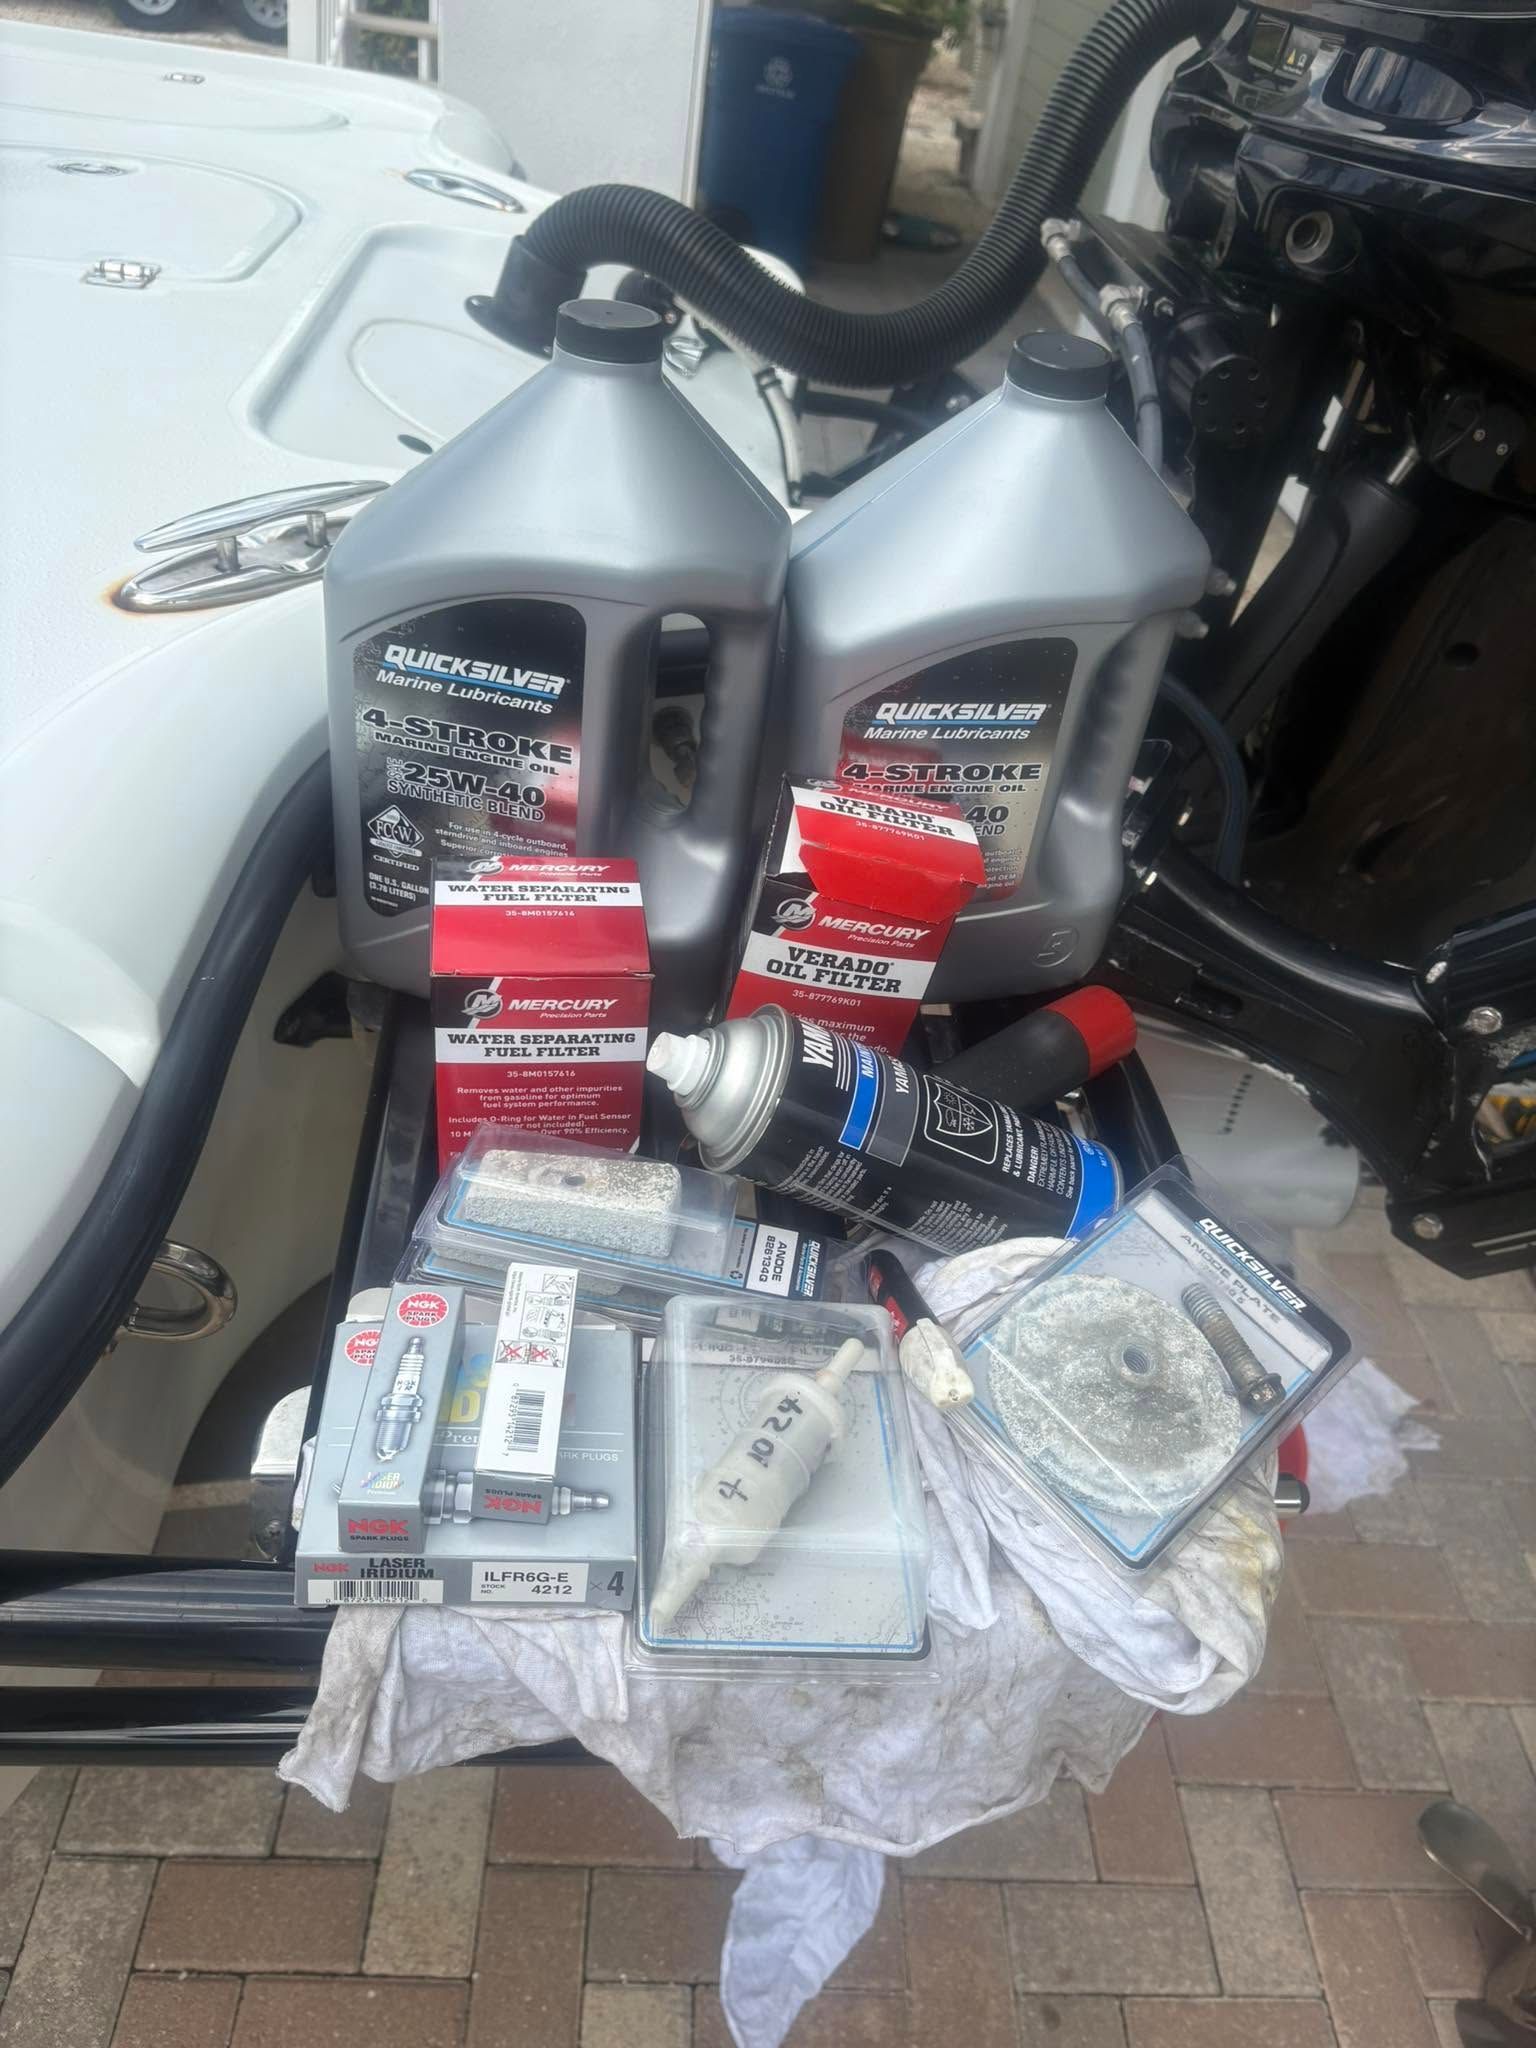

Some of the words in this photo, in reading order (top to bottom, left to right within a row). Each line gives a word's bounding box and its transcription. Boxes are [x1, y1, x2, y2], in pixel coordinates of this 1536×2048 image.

[384, 644, 565, 696] QUICKSILVER
[376, 669, 443, 694] Marine
[447, 683, 553, 714] Lubricants
[875, 703, 1048, 725] QUICKSILVER
[362, 707, 574, 765] 4-STROKE
[864, 727, 928, 739] Marine
[931, 727, 1031, 740] Lubricants
[375, 731, 449, 755] MARINE
[454, 746, 524, 770] ENGINE
[529, 763, 560, 776] OIL
[842, 763, 1043, 782] 4-STROKE
[403, 761, 546, 807] 25W-40
[853, 784, 924, 793] ARINE
[927, 784, 995, 793] ENGINE
[999, 784, 1026, 792] OIL
[388, 780, 482, 810] SYNTHETIC
[487, 795, 545, 822] BLEND
[833, 796, 934, 823] VERADO
[820, 801, 861, 816] OIL
[863, 810, 955, 837] FILTER
[435, 829, 478, 841] sterndrive
[481, 837, 496, 845] and
[449, 822, 462, 830] For
[465, 826, 480, 834] use
[494, 831, 523, 843] 4-cycle
[974, 824, 1005, 836] END
[440, 839, 477, 852] Superior
[373, 854, 419, 871] CERTIFIED
[369, 872, 383, 882] ONE
[384, 875, 400, 887] U.S.
[401, 881, 429, 895] GALLON
[448, 885, 514, 893] WATER
[518, 885, 630, 894] SEPARATING
[389, 887, 416, 901] LITERS)
[483, 893, 530, 901] FUEL
[535, 894, 598, 902] FILTER
[818, 916, 931, 940] MERCURY
[848, 934, 890, 946] Precision
[892, 941, 915, 949] Parts
[788, 946, 890, 976] VERADO
[767, 959, 807, 980] OIL
[812, 969, 902, 993] FILTER
[508, 999, 619, 1011] MERCURY
[792, 989, 862, 1007] 35-877769K01
[817, 1018, 875, 1033] maximum
[448, 1034, 516, 1044] WATER
[520, 1033, 636, 1044] SEPARATING
[848, 1033, 866, 1043] the
[484, 1047, 532, 1057] FUEL
[536, 1047, 601, 1057] FILTER
[577, 1085, 623, 1094] impurities
[503, 1094, 543, 1103] gasoline
[560, 1093, 601, 1102] optimum
[503, 1101, 536, 1109] system
[538, 1099, 599, 1108] performance.
[489, 1116, 522, 1125] O-Ring
[1002, 1133, 1012, 1172] REPLACES
[1026, 1145, 1038, 1183] DANGER!
[1036, 1148, 1048, 1187] EXTREMELY
[1065, 1185, 1074, 1198] See
[770, 1240, 787, 1282] ANODE
[800, 1240, 821, 1296] QUICKSILVER
[1199, 1218, 1307, 1313] QUICKSILVER
[1181, 1234, 1232, 1283] ANODE
[1232, 1280, 1281, 1324] PLATE
[407, 1300, 440, 1310] NGK
[355, 1338, 380, 1347] NG
[582, 1452, 618, 1461] PLUGS
[484, 1488, 510, 1496] PLUGS
[512, 1490, 542, 1499] SPARK
[483, 1496, 543, 1514] NGK
[347, 1519, 409, 1535] NGK
[314, 1563, 348, 1572] NGK
[369, 1558, 425, 1569] LASER
[360, 1568, 435, 1579] IRIDIUM
[484, 1571, 569, 1583] ILFR6G-E
[531, 1585, 573, 1595] 4212
[607, 1571, 624, 1596] 4
